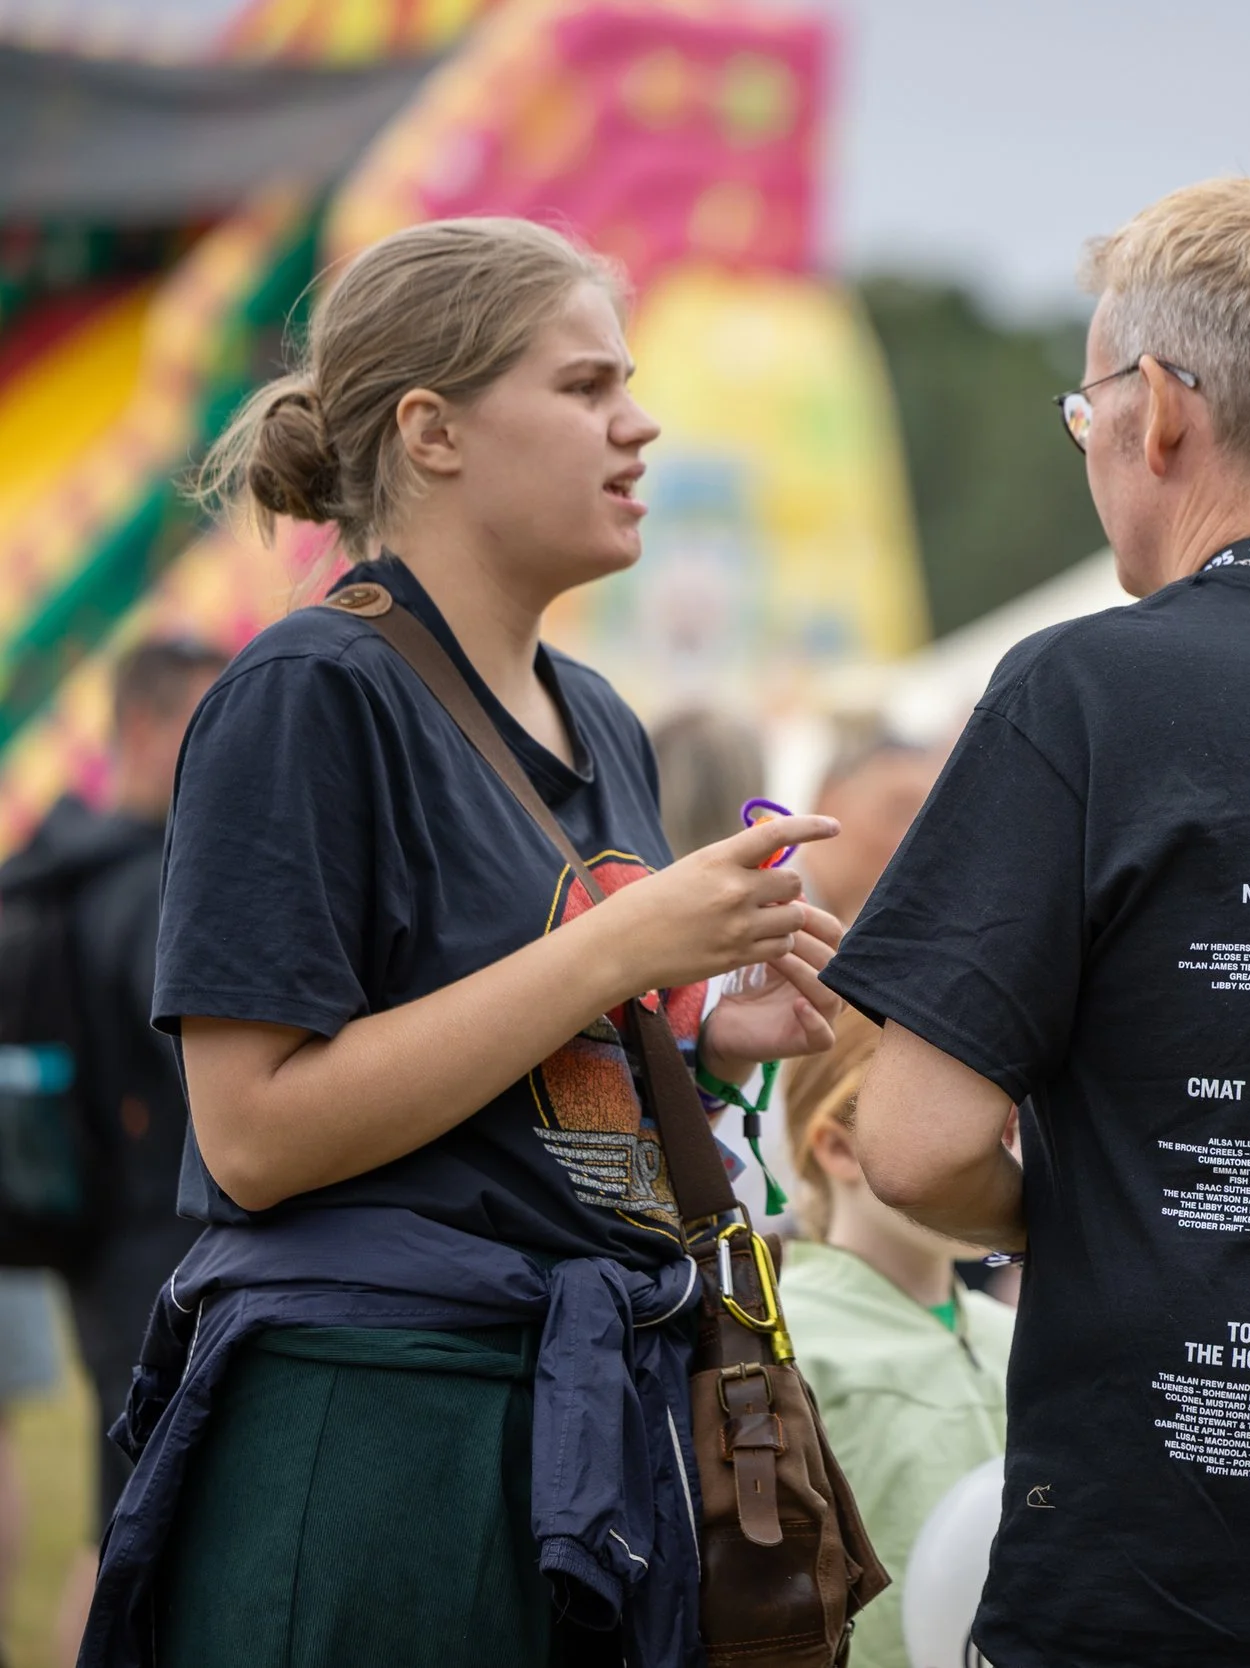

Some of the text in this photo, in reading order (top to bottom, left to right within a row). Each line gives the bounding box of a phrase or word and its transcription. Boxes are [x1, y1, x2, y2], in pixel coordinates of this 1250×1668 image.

[1190, 943, 1209, 951] AMY
[1213, 953, 1241, 961] CLOSE
[1178, 961, 1208, 969] DYLAN
[1209, 962, 1238, 970] JAMES
[1211, 982, 1237, 990] LIBBY
[1187, 1077, 1246, 1100] CMAT
[1208, 1138, 1232, 1147] AILSA
[1158, 1140, 1174, 1150] THE
[1175, 1143, 1208, 1154] BROKEN
[1210, 1148, 1243, 1157] CREELS
[1213, 1167, 1238, 1175] EMMA
[1229, 1177, 1248, 1185] FISH
[1196, 1183, 1222, 1192] ISAAC
[1180, 1192, 1204, 1200] KATIE
[1206, 1193, 1241, 1203] WATSON
[1161, 1208, 1225, 1221] SUPERDANDIES
[1178, 1220, 1218, 1230] OCTOBER
[1219, 1223, 1244, 1232] DRIFT
[1184, 1342, 1224, 1366] THE
[1176, 1375, 1199, 1385] ALAN
[1200, 1379, 1225, 1388] FREW
[1151, 1381, 1247, 1401] BLUENESS BOHEMIAN
[1165, 1393, 1246, 1410] COLONEL MUSTARD
[1200, 1407, 1224, 1417] DAVID
[1175, 1413, 1196, 1423] FASH
[1198, 1416, 1238, 1429] STEWART
[1154, 1420, 1225, 1436] GABRIELLE APLIN
[1175, 1432, 1196, 1442] LUSA
[1165, 1440, 1247, 1458] NELSON'S MANDOLA
[1169, 1451, 1225, 1465] POLLY NOBLE
[1206, 1466, 1228, 1475] RUTH
